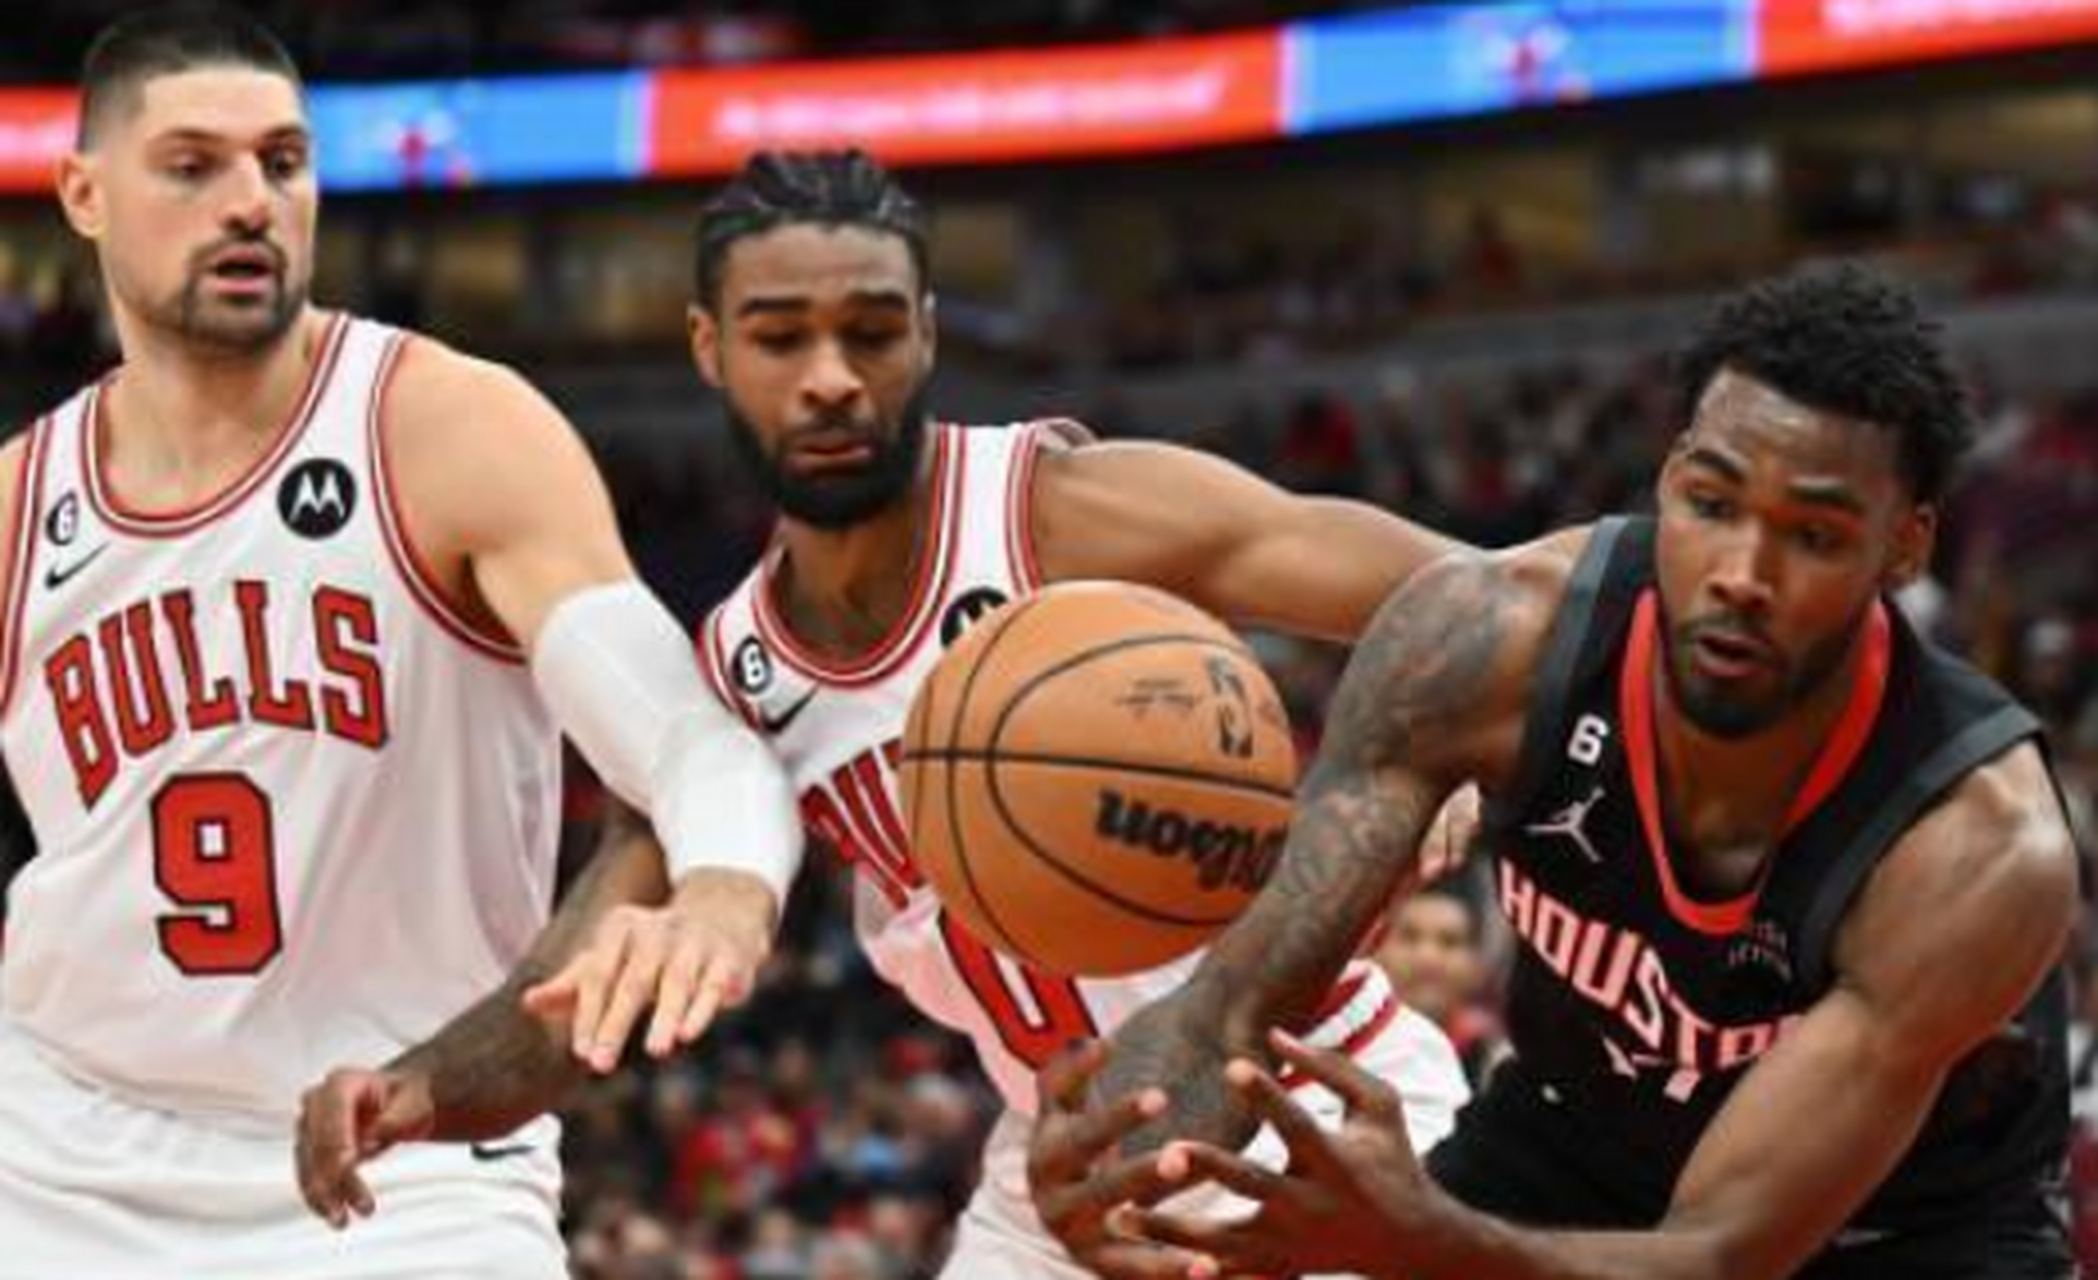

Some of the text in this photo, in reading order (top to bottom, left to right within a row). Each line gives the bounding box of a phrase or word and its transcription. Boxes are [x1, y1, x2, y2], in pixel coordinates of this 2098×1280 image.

[44, 580, 390, 812] BULLS
[1567, 714, 1609, 766] 6
[150, 772, 283, 976] 9
